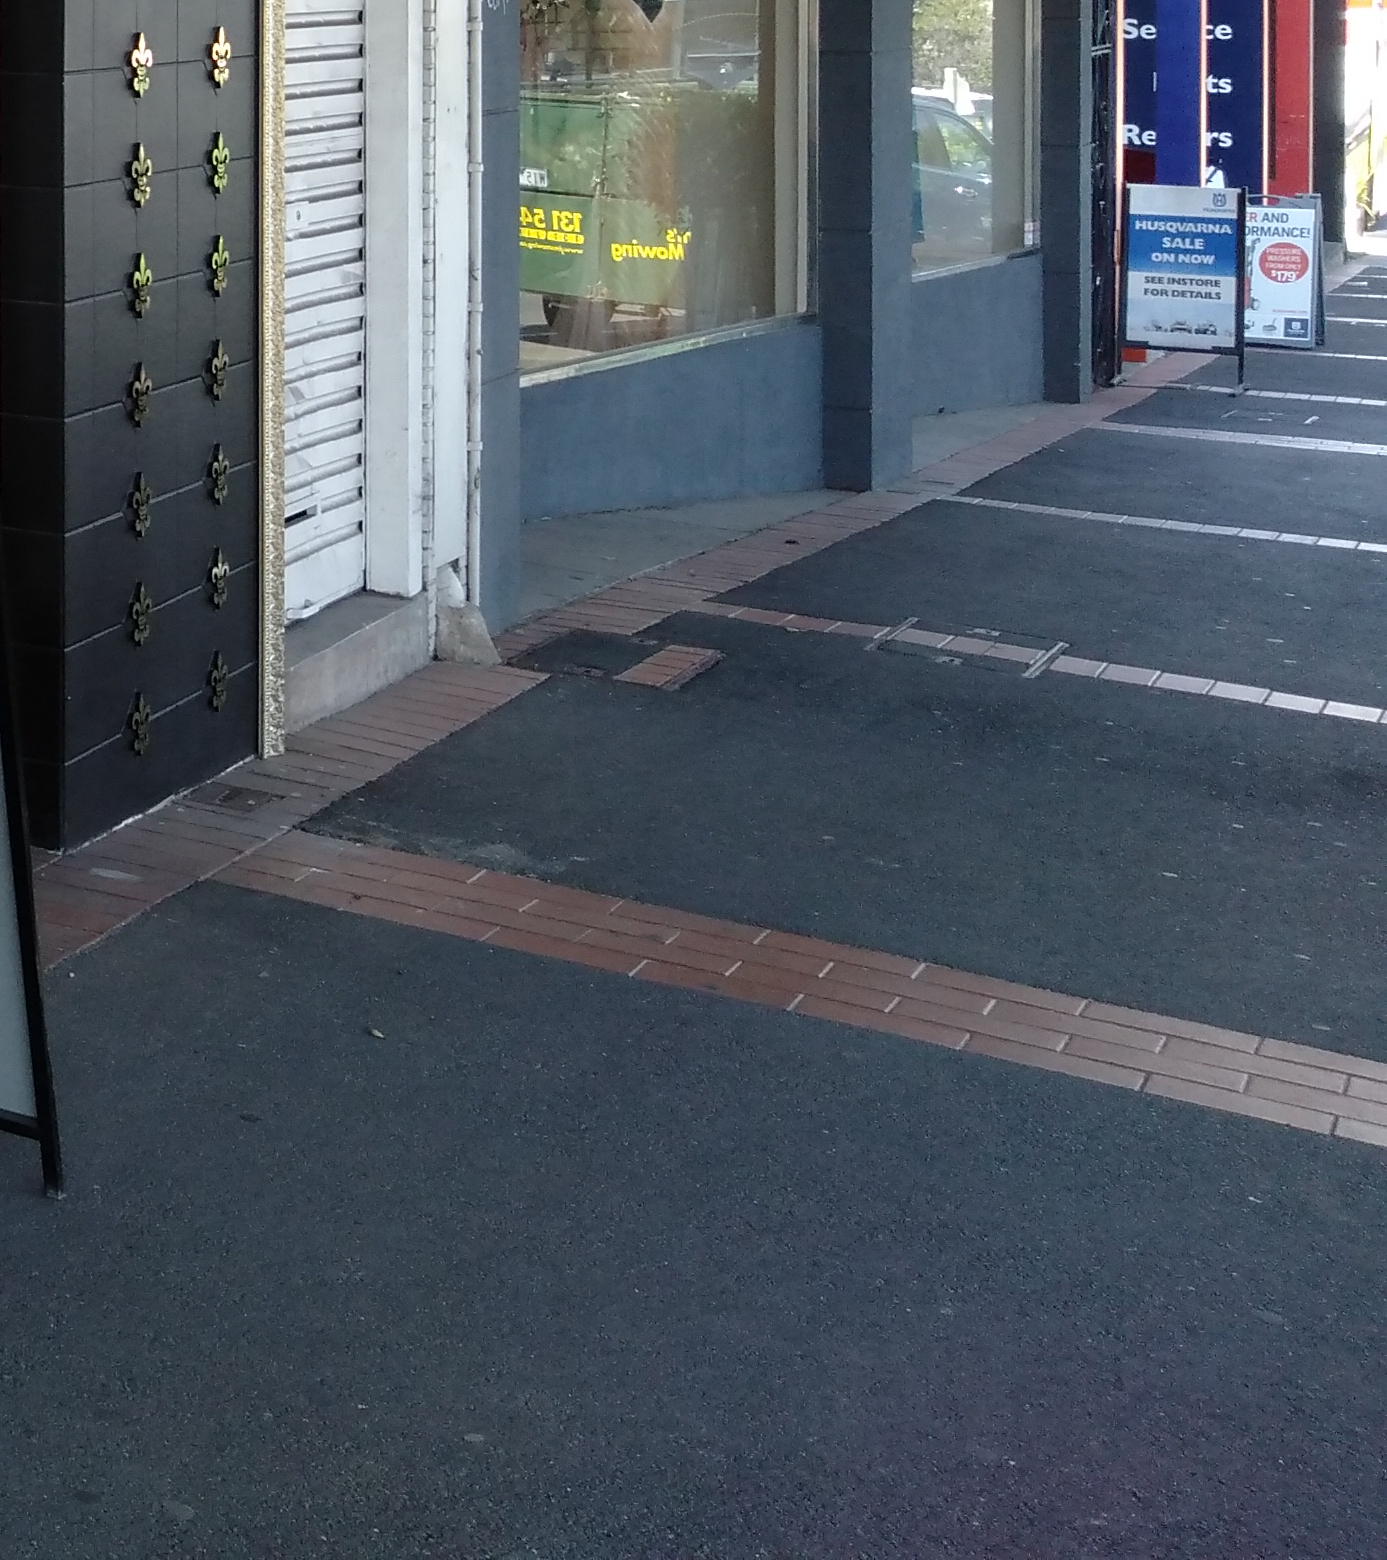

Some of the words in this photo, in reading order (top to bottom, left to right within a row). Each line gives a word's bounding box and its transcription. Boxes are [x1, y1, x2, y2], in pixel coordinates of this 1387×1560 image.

[1262, 212, 1289, 224] AND
[1134, 220, 1233, 235] HUSQVARNA
[1161, 237, 1205, 250] SALE
[1151, 252, 1175, 263] ON
[1178, 253, 1216, 265] NOW
[1144, 275, 1165, 285] SEE
[1167, 277, 1221, 288] INSTORE
[1143, 288, 1171, 298] FOR
[1171, 289, 1222, 301] DETAILS
